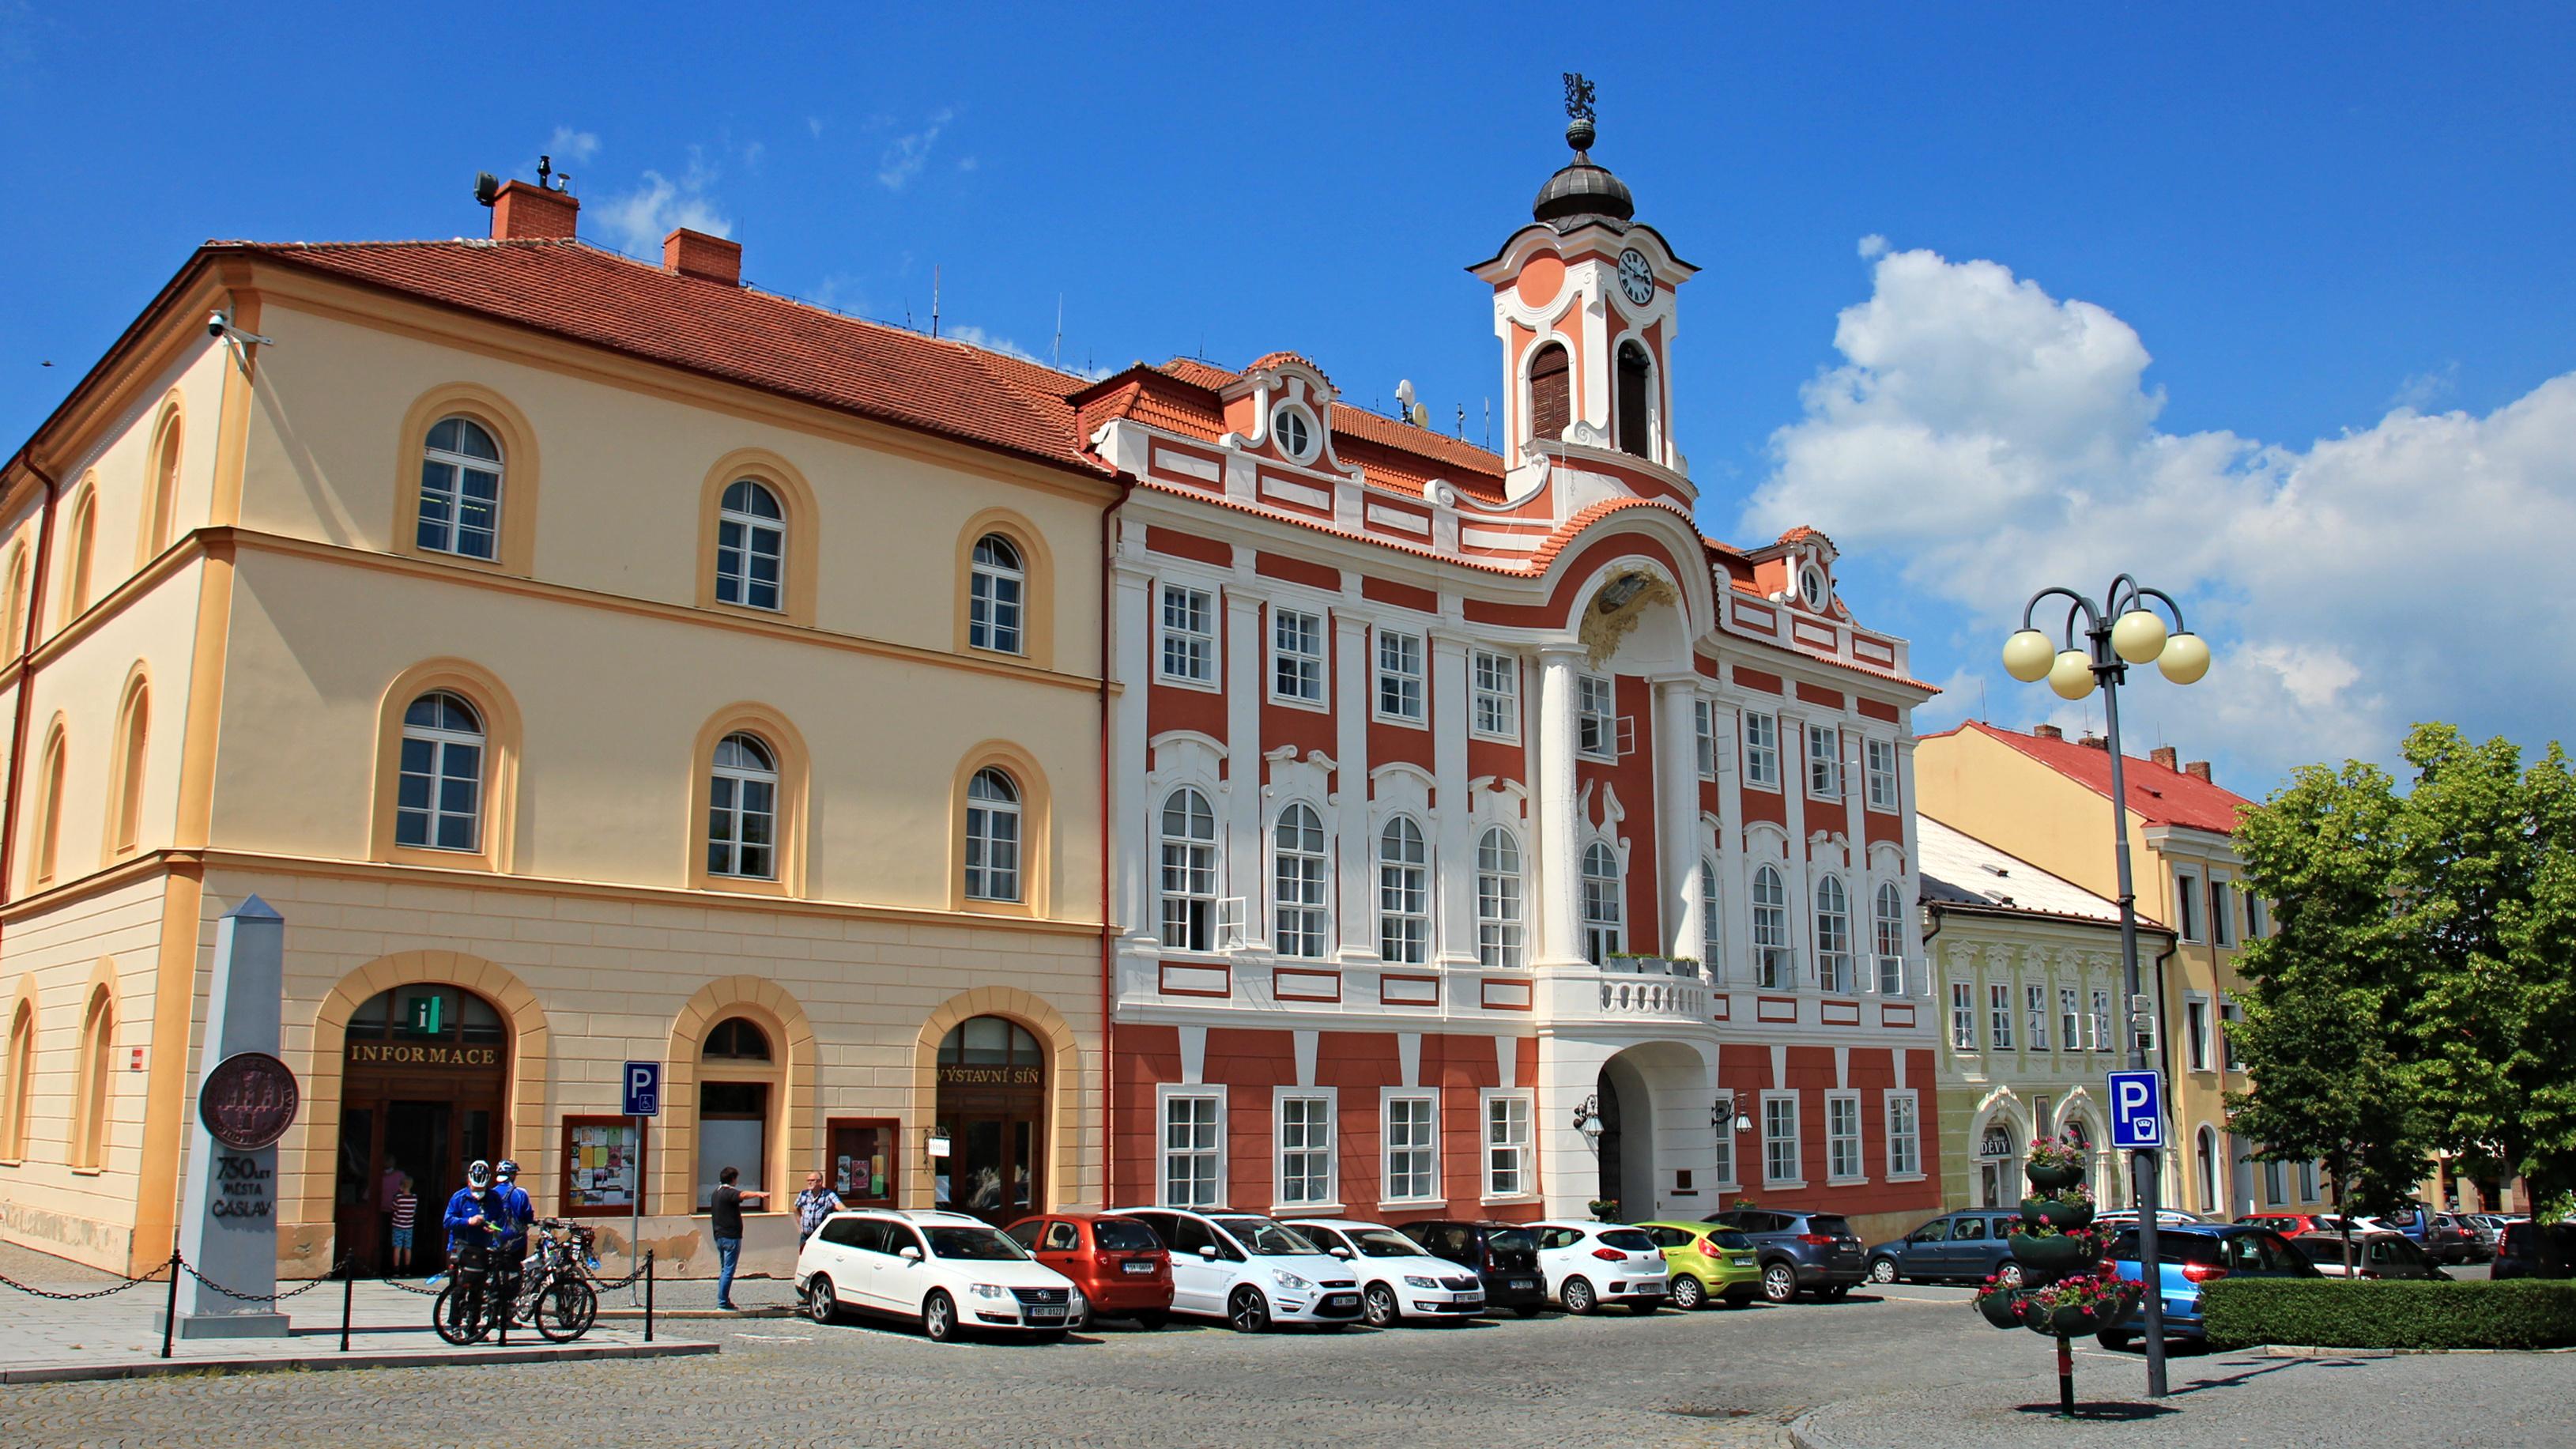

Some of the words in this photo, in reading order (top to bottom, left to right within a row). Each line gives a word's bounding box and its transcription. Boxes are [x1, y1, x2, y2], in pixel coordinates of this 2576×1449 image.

[352, 1045, 494, 1064] INFORMACE
[632, 1069, 651, 1098] P
[937, 1066, 1009, 1082] VÝSTAVNÍ
[1014, 1067, 1039, 1083] SÍŇ
[2120, 1081, 2148, 1123] P
[217, 1157, 255, 1179] 750
[255, 1169, 270, 1179] LET
